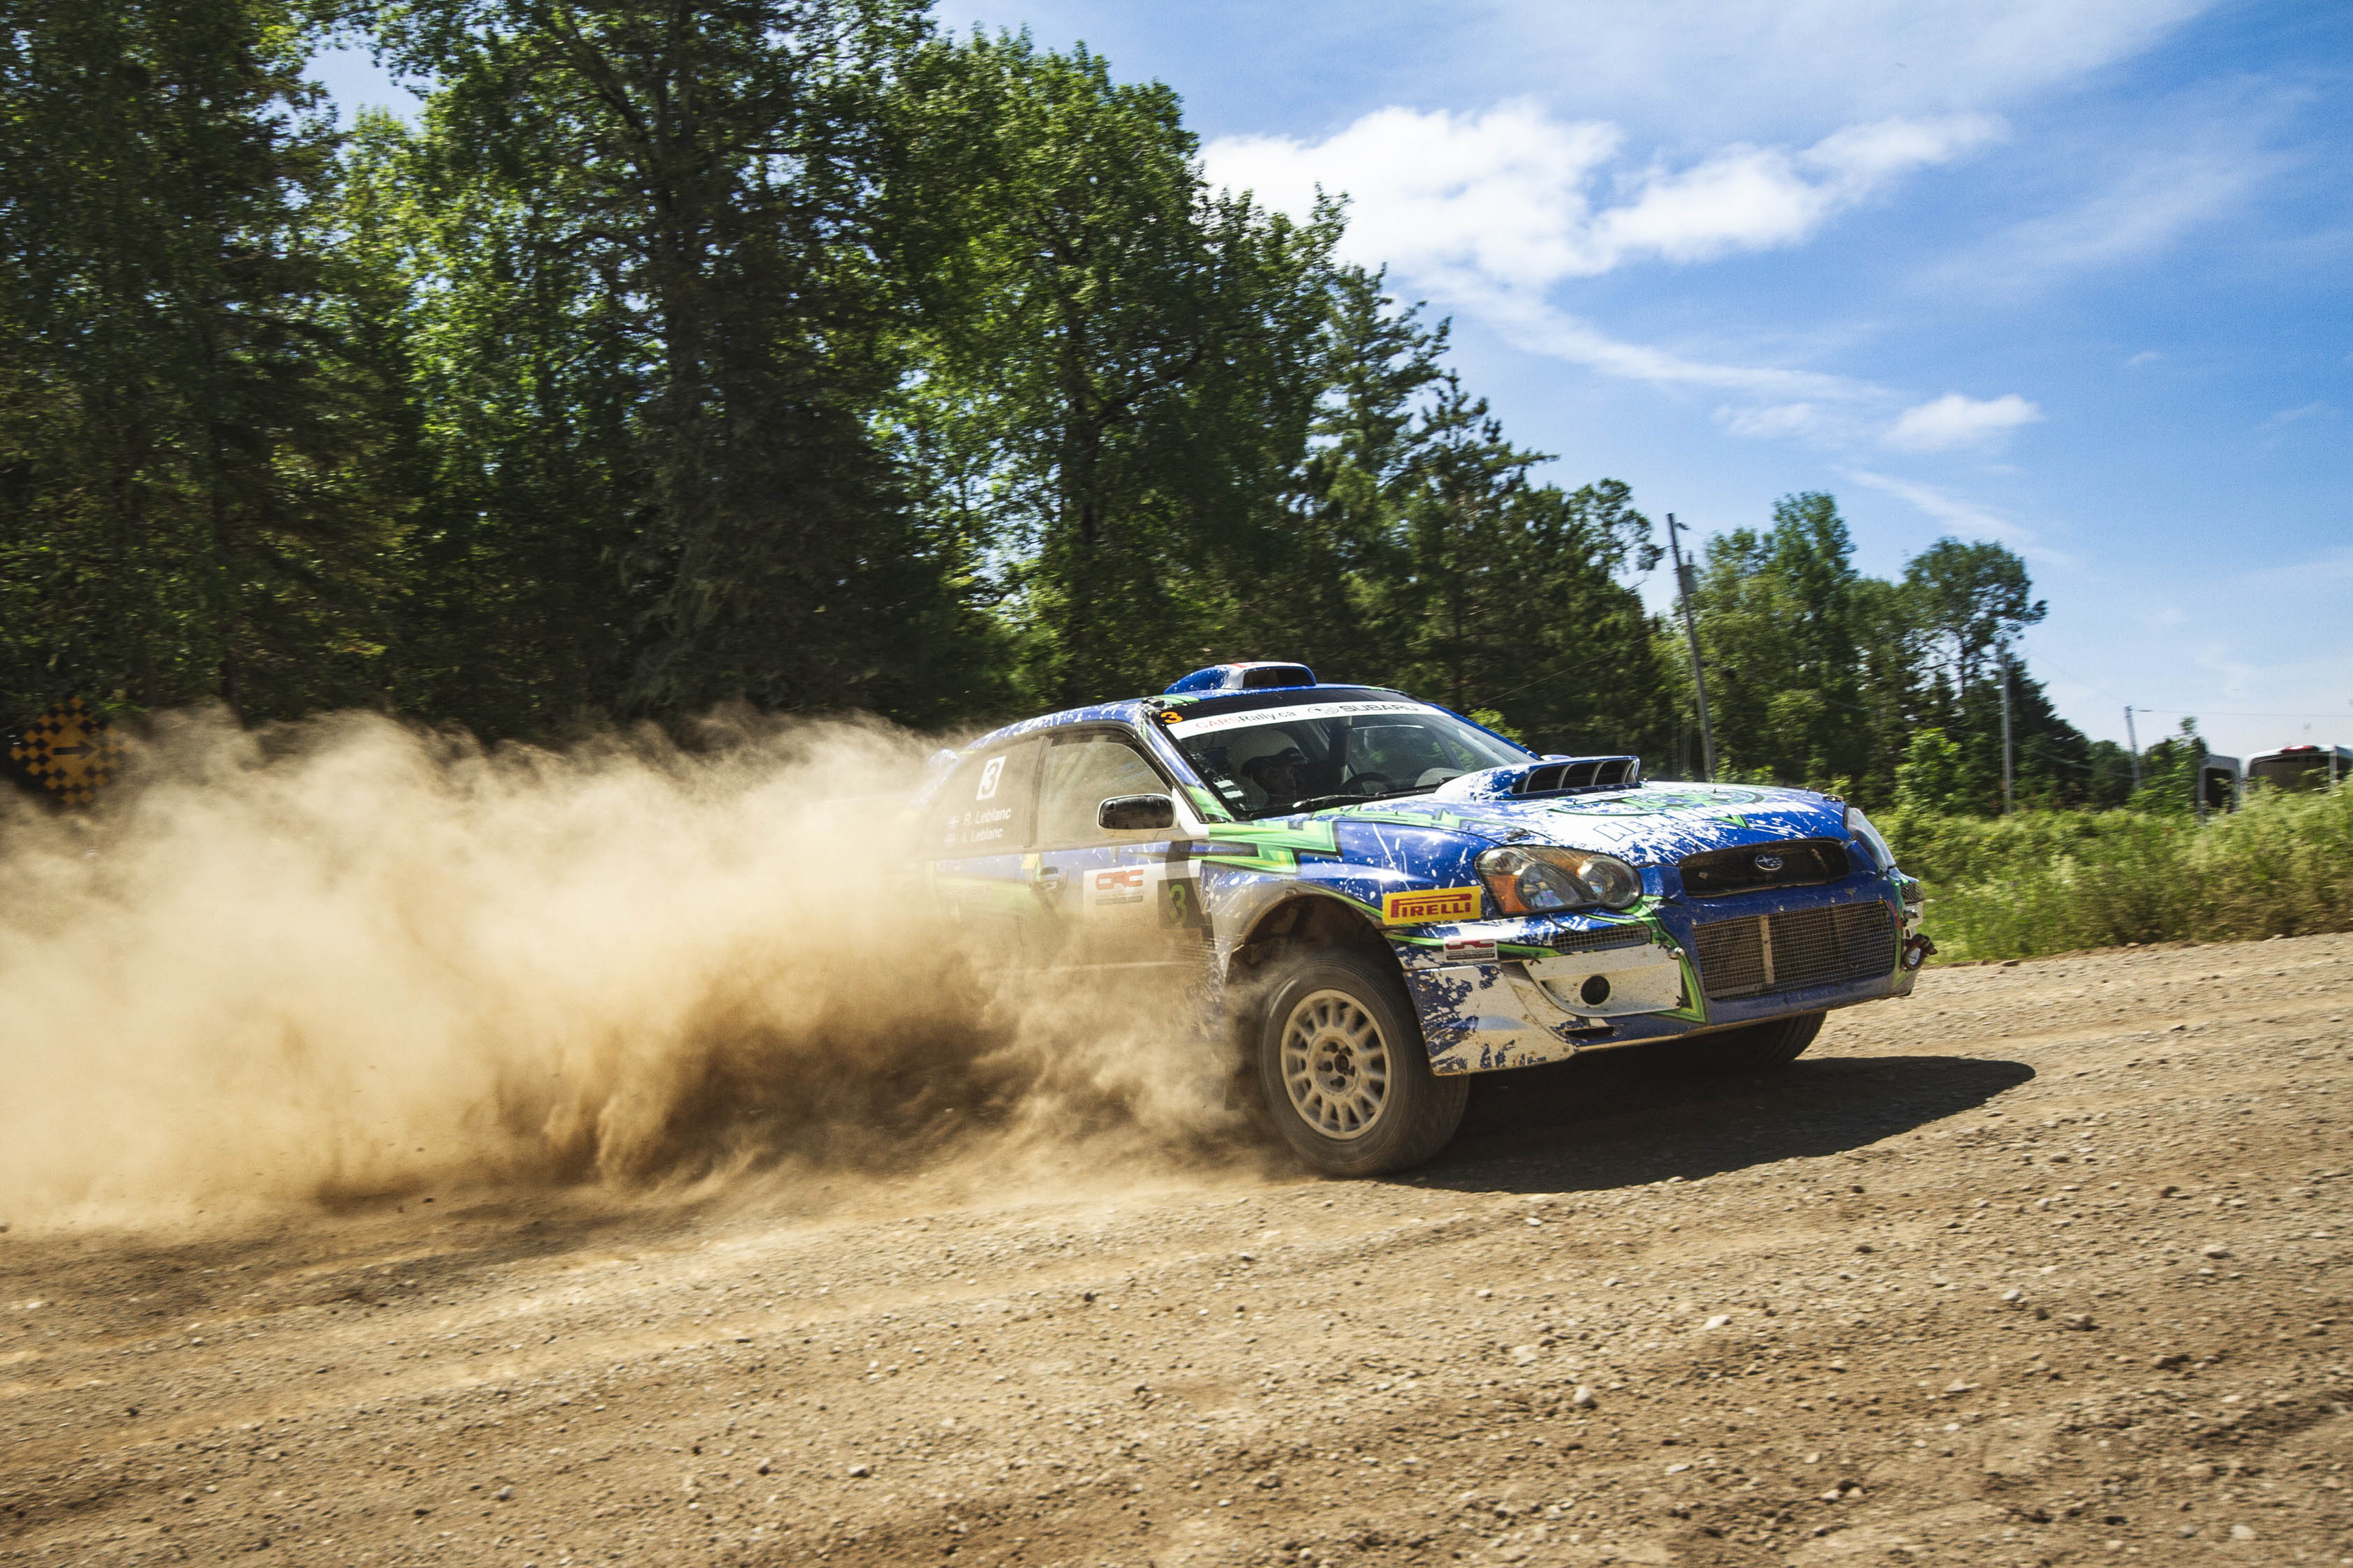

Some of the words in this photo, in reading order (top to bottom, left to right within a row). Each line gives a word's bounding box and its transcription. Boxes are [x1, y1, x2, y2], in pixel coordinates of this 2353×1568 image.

[1160, 711, 1183, 723] 3
[1195, 710, 1295, 729] CARSRally.ca
[982, 761, 1000, 795] 3
[974, 808, 1012, 824] Leblanc
[970, 828, 1003, 843] Leblanc
[1096, 868, 1144, 891] CRC
[1169, 884, 1188, 928] 3
[1390, 893, 1473, 918] PIRELLI
